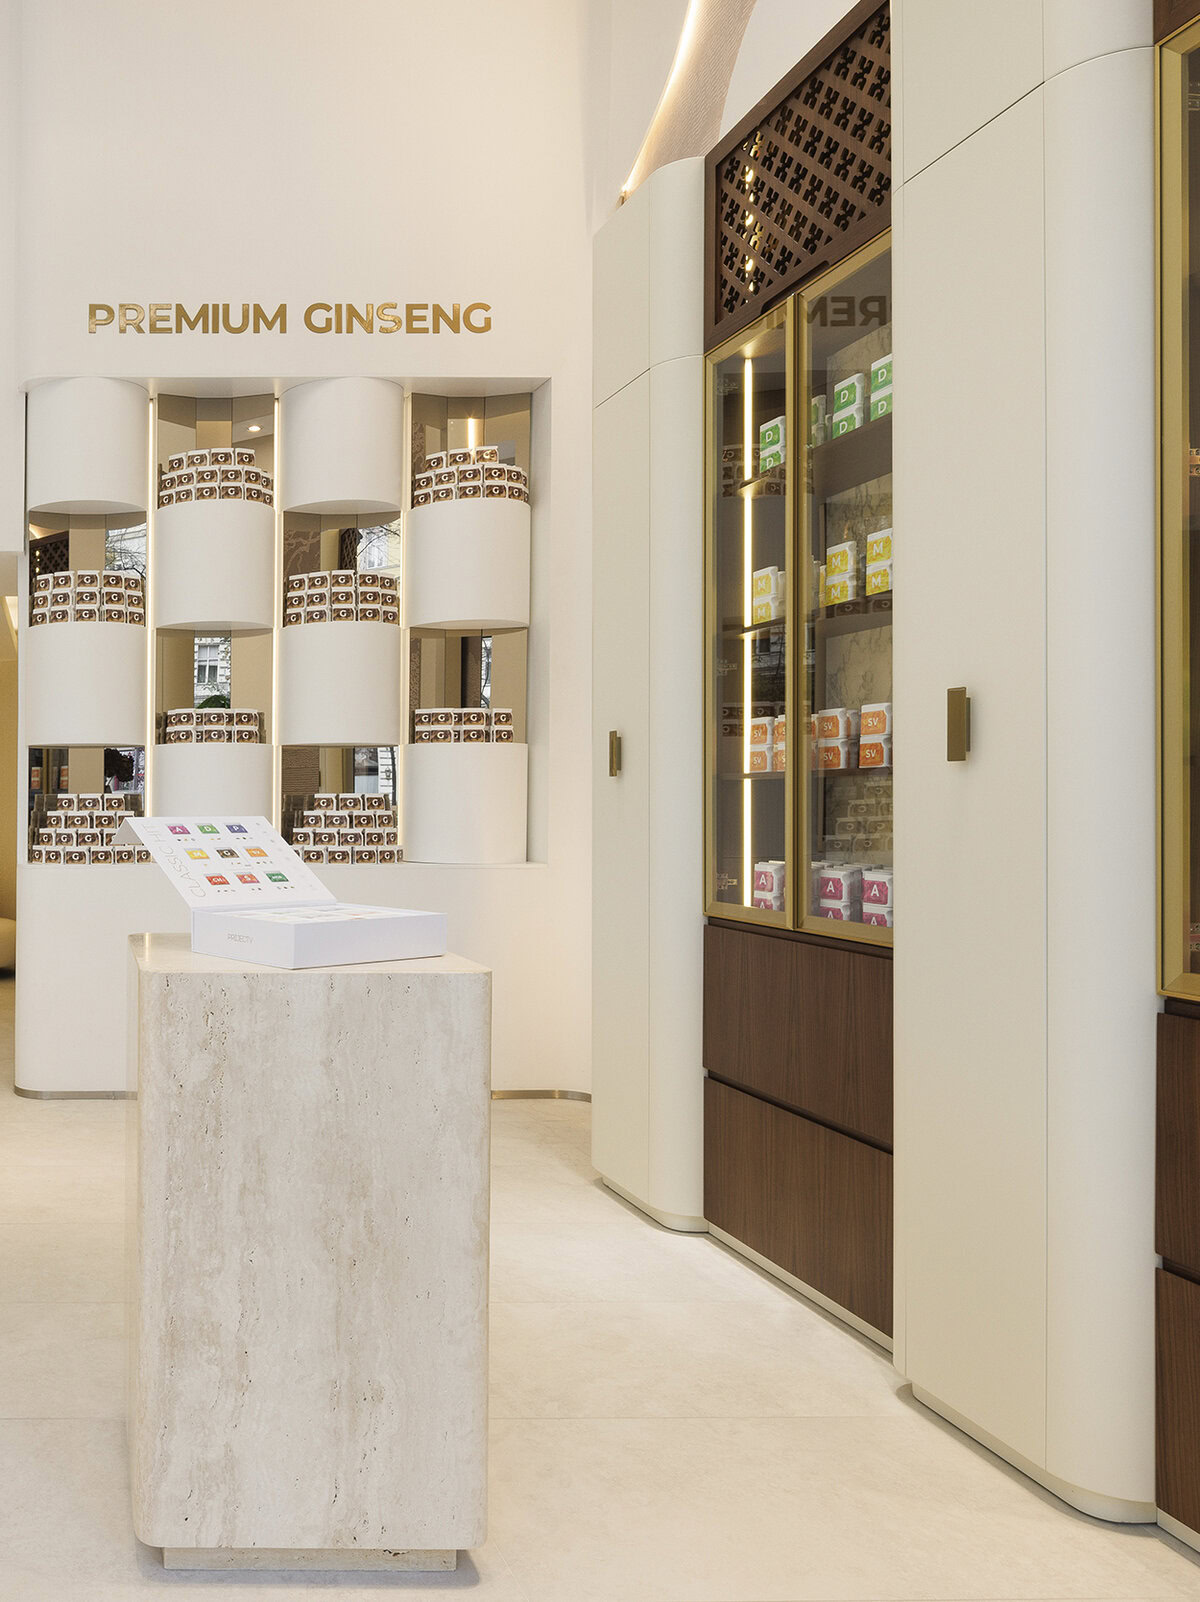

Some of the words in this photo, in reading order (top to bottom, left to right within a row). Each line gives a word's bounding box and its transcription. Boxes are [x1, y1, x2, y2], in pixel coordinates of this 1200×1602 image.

[88, 303, 287, 334] PREMIUM
[303, 302, 492, 334] GINSENG
[878, 368, 887, 383] D
[840, 390, 849, 403] D
[878, 401, 887, 414] D
[839, 421, 848, 434] D
[766, 431, 773, 443] D
[873, 541, 883, 556] M
[832, 555, 841, 569] M
[872, 575, 881, 588] M
[831, 586, 841, 599] M
[823, 722, 833, 731] SV
[868, 717, 879, 727] SV
[754, 729, 762, 738] SV
[753, 756, 762, 765] SV
[824, 752, 834, 761] SV
[865, 749, 877, 759] SV
[759, 874, 767, 885] A
[826, 881, 835, 893] A
[870, 884, 880, 897] A
